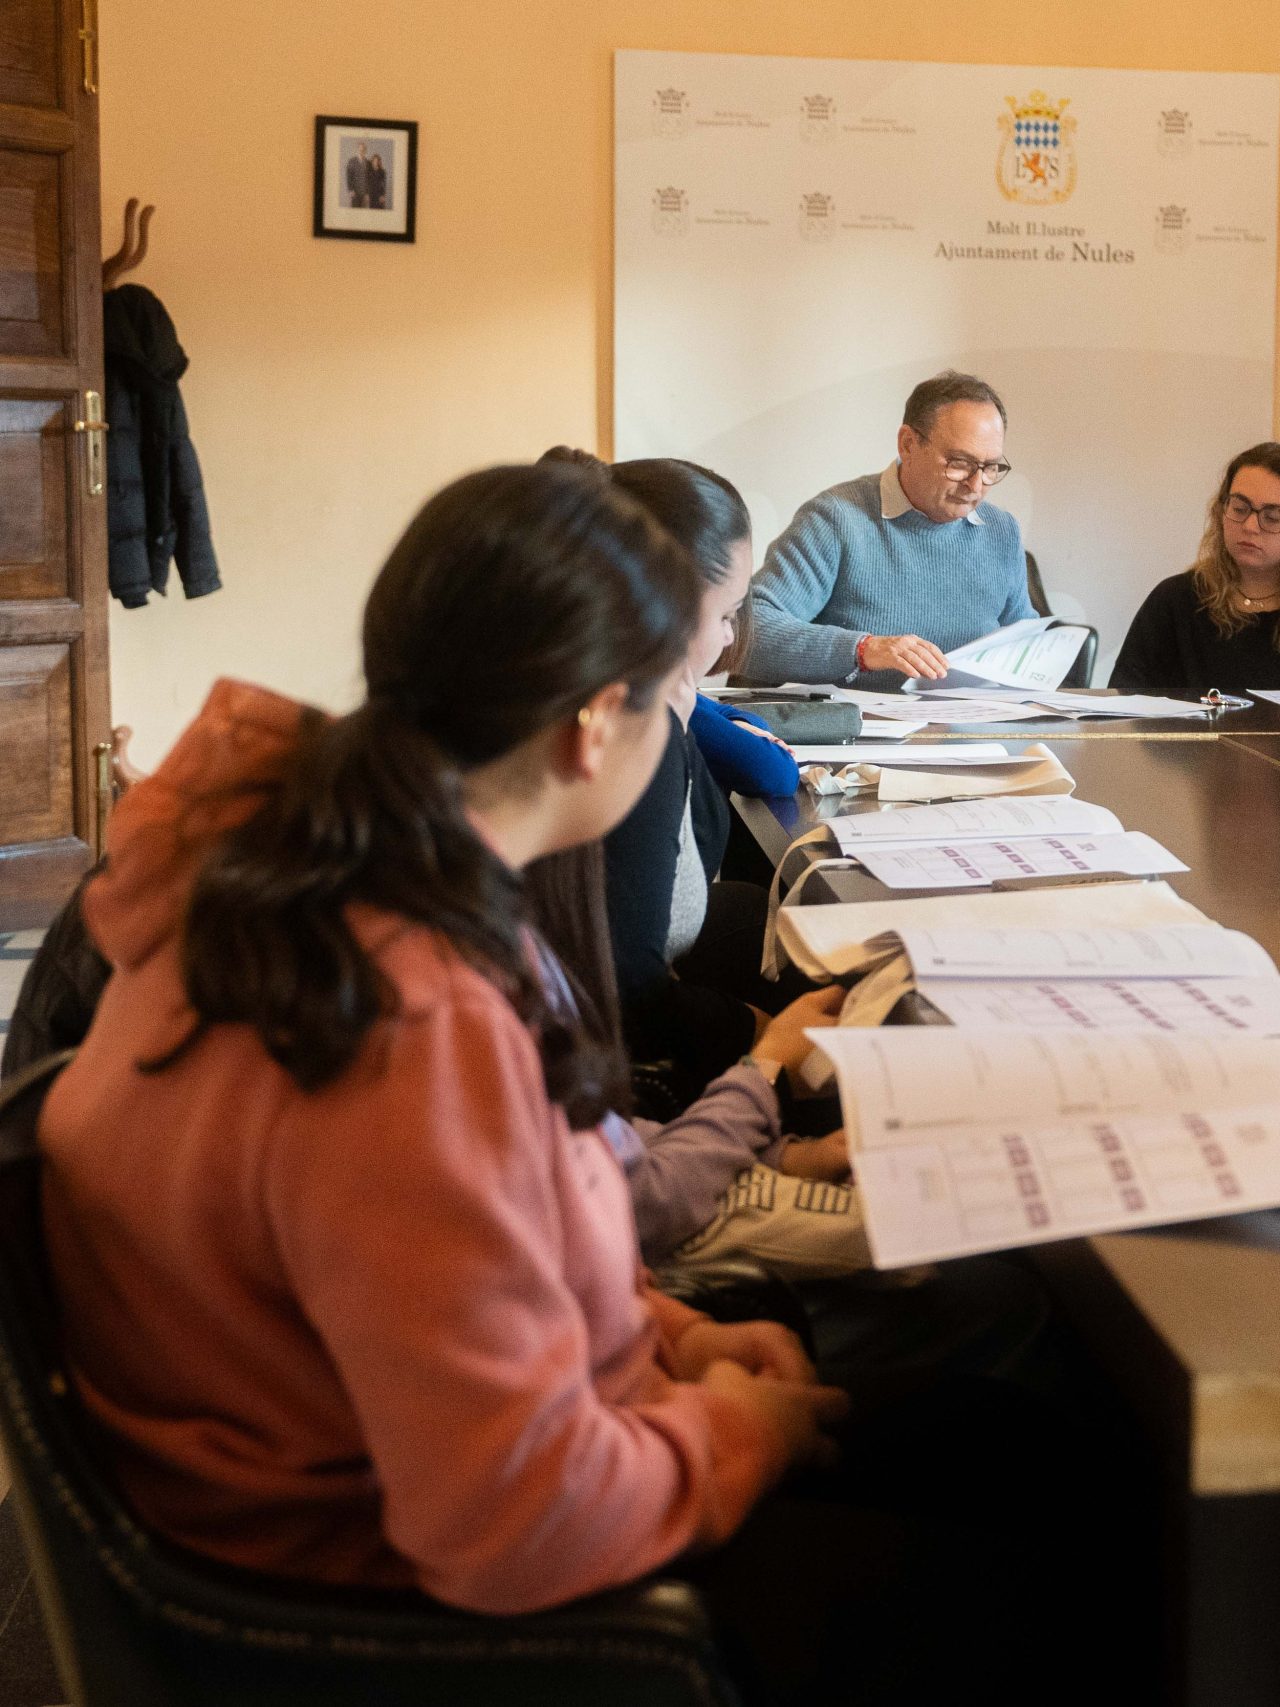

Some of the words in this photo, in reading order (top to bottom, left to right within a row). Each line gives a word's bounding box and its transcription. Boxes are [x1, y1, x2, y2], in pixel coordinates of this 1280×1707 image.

[987, 221, 1020, 235] Molt
[934, 242, 1039, 261] Ajuntament
[1045, 246, 1065, 261] de
[1072, 242, 1135, 264] Nules
